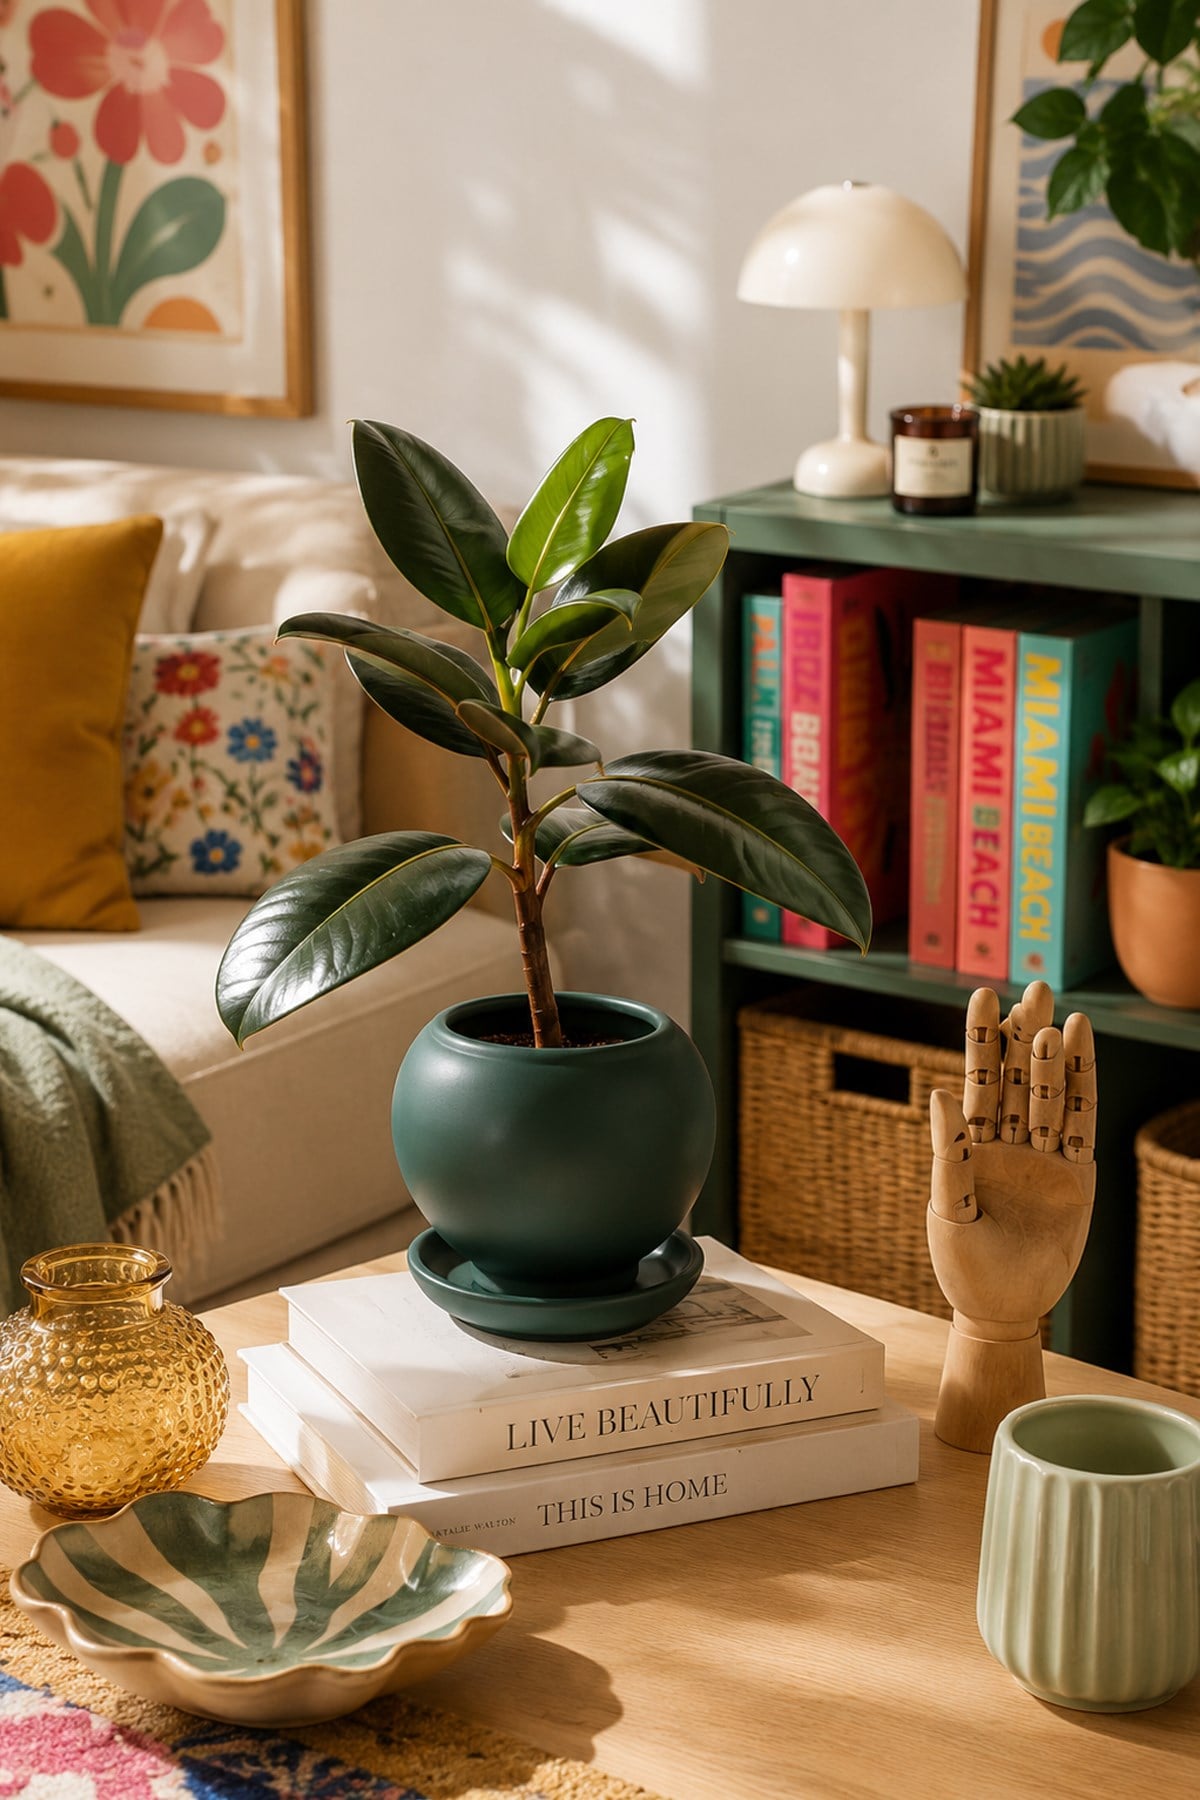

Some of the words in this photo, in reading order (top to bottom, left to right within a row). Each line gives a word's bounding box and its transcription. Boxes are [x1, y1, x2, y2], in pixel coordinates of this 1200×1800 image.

[972, 647, 1005, 797] MIAMI
[1021, 652, 1062, 818] MIAMI
[969, 804, 1000, 929] BEACH
[1018, 821, 1053, 942] BEACH
[506, 1412, 586, 1451] LIVE
[597, 1374, 820, 1437] BEAUTIFULLY
[537, 1494, 604, 1527] THIS
[611, 1489, 635, 1514] IS
[643, 1473, 729, 1508] HOME
